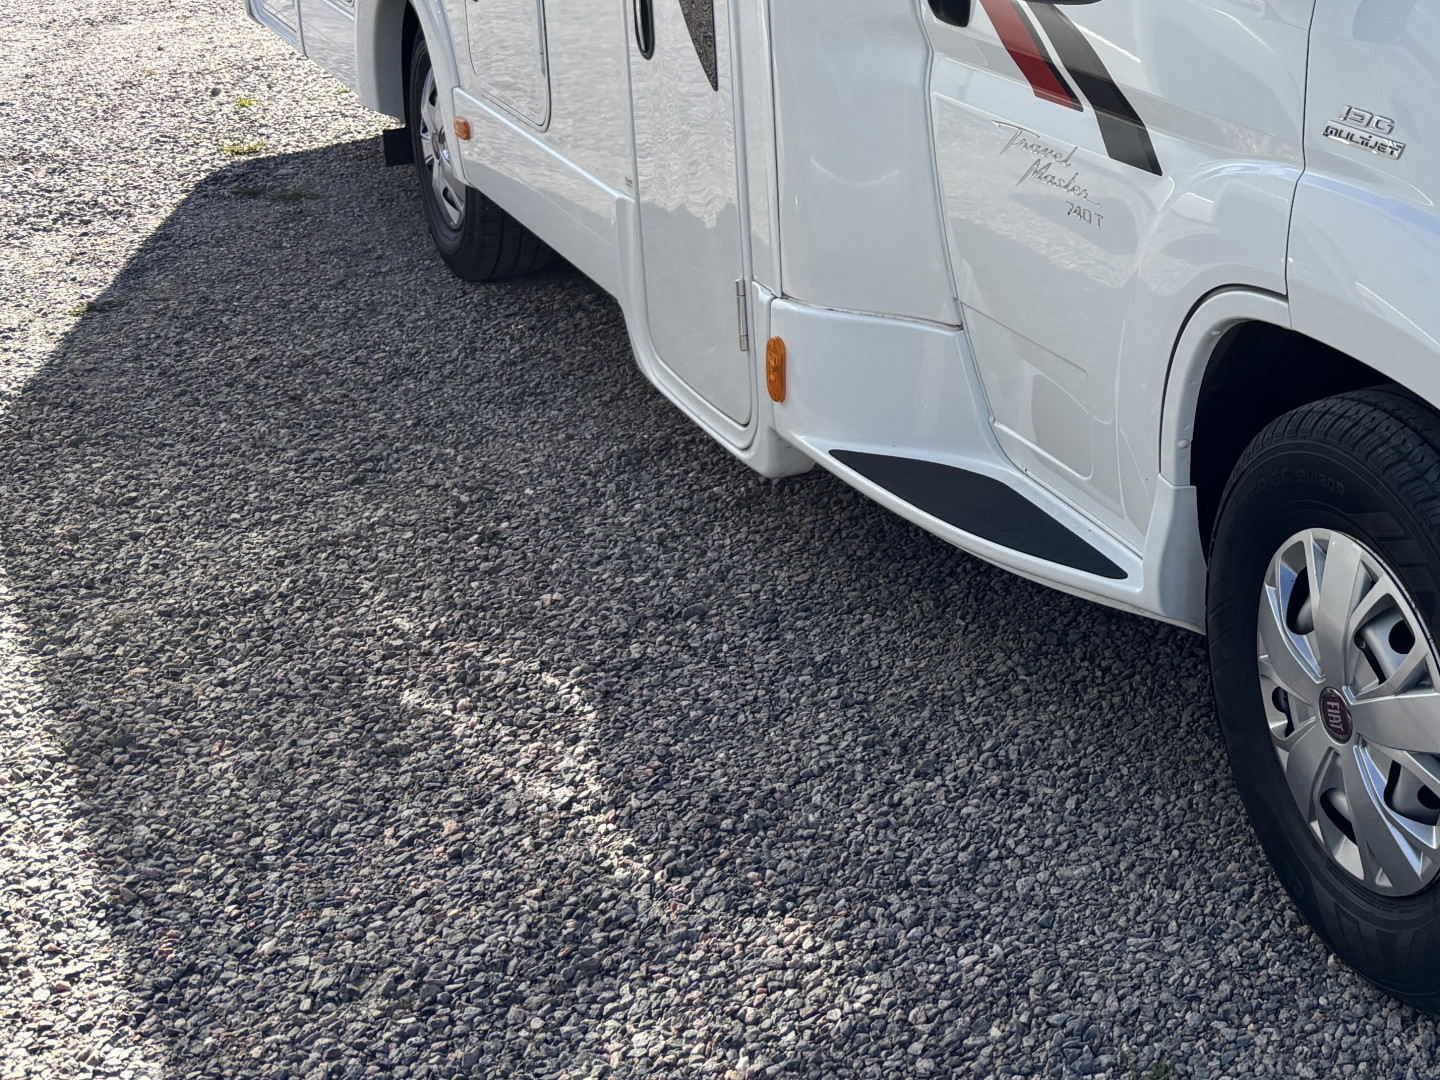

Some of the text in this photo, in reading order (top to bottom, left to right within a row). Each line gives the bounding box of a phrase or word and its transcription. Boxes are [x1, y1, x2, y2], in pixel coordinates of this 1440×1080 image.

[991, 120, 1078, 167] Travel
[1016, 158, 1102, 208] Master
[1326, 701, 1344, 732] FIAT
